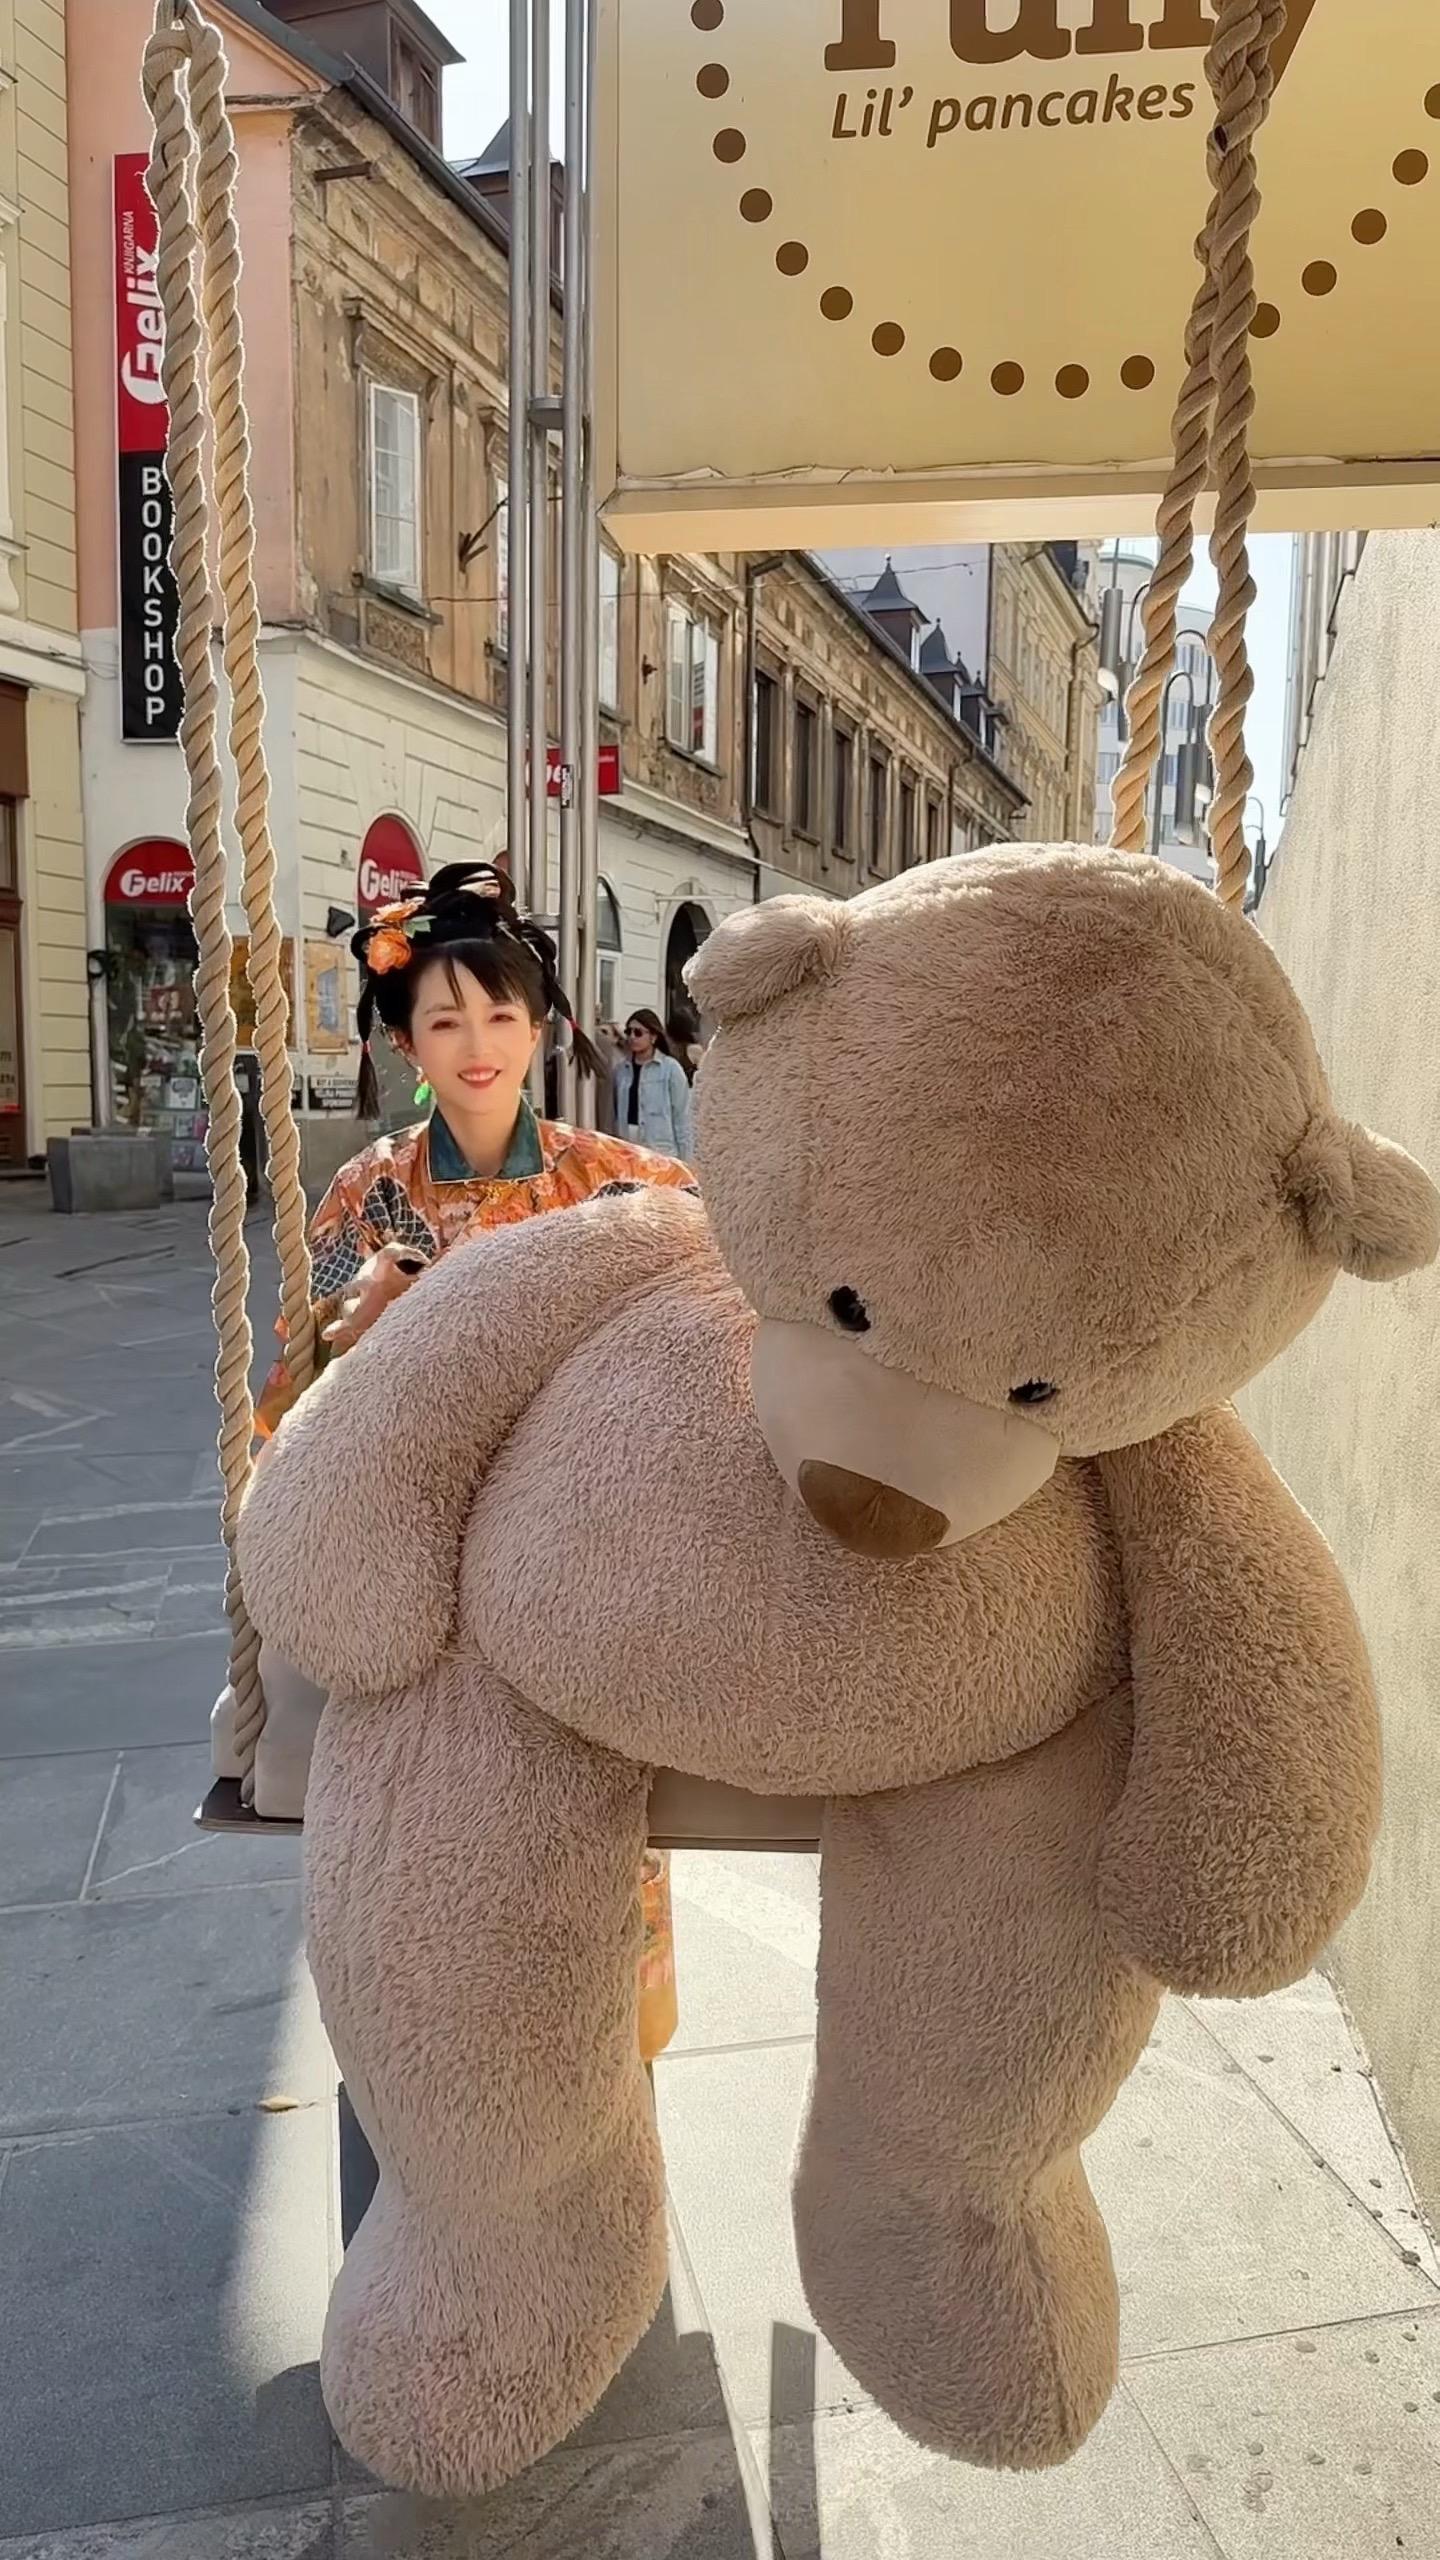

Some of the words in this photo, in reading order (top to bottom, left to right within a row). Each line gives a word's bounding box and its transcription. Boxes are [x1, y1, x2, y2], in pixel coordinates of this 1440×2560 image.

[926, 73, 1196, 148] pancakes
[123, 211, 134, 275] KNJIGARNA
[121, 246, 165, 404] Felix
[142, 466, 165, 725] BOOKSHOP
[120, 869, 185, 897] Felix
